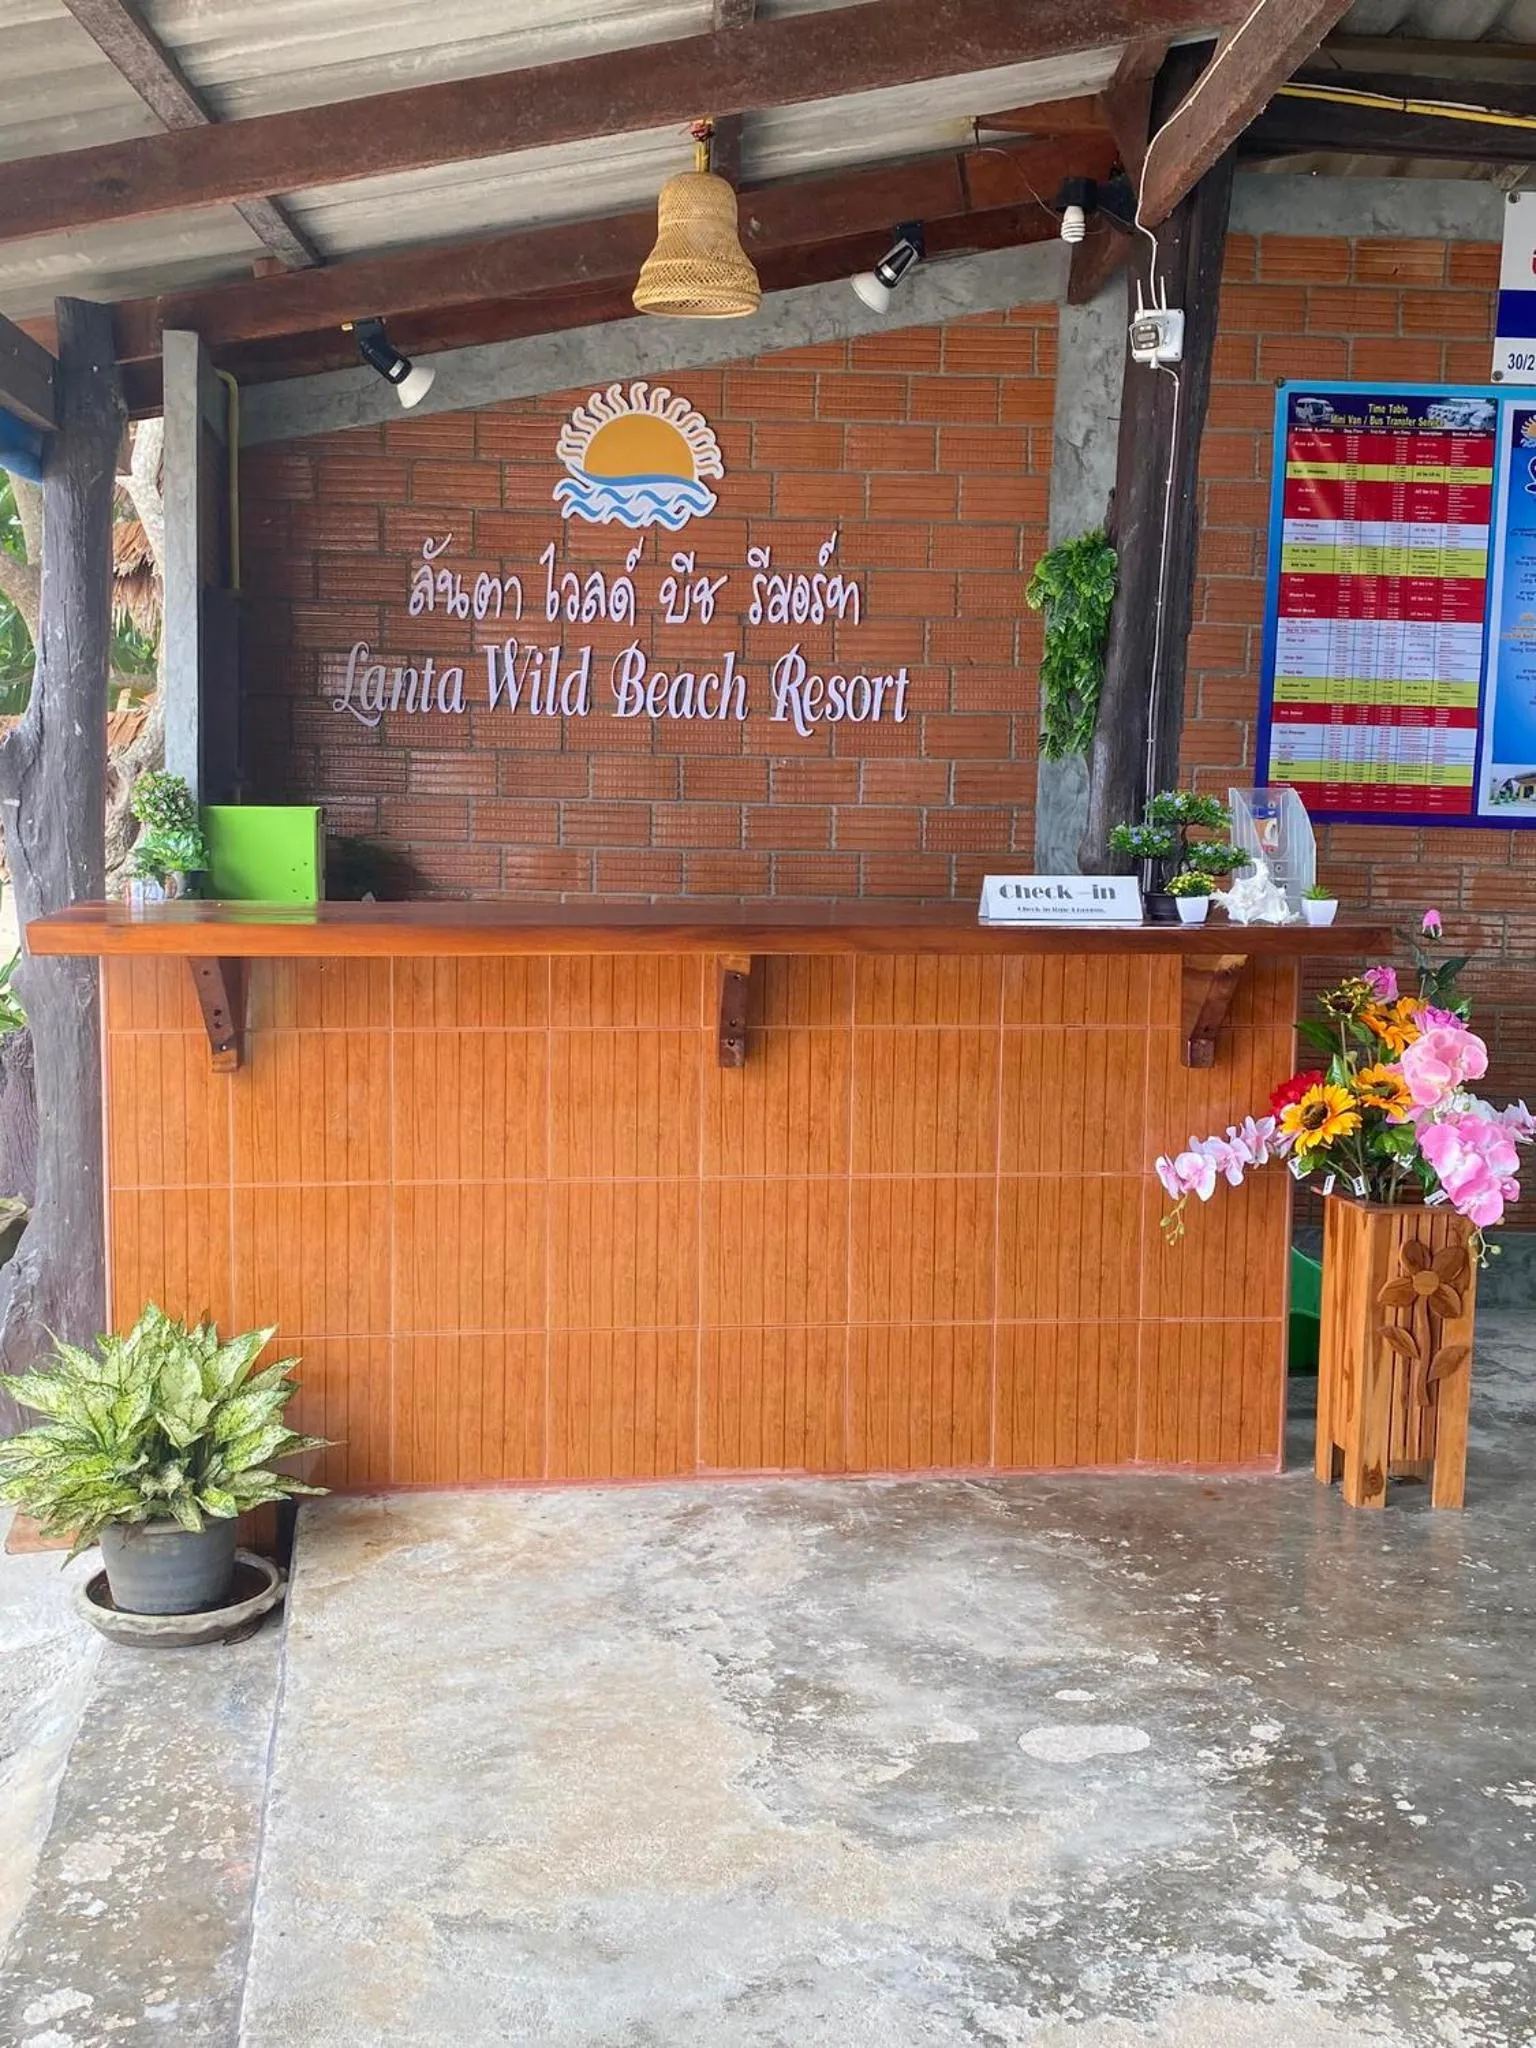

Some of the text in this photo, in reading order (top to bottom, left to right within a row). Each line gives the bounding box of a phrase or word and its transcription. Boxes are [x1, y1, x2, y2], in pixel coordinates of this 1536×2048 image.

[1368, 403, 1409, 414] Time Table
[1348, 415, 1362, 425] Van
[1369, 415, 1384, 426] Bus
[1386, 415, 1417, 427] Transfer
[409, 530, 861, 627] ลันตา ไวลด์ บีช รีสอร์ท
[332, 638, 910, 738] Lanta Wild Beach Resort
[999, 884, 1074, 900] Check
